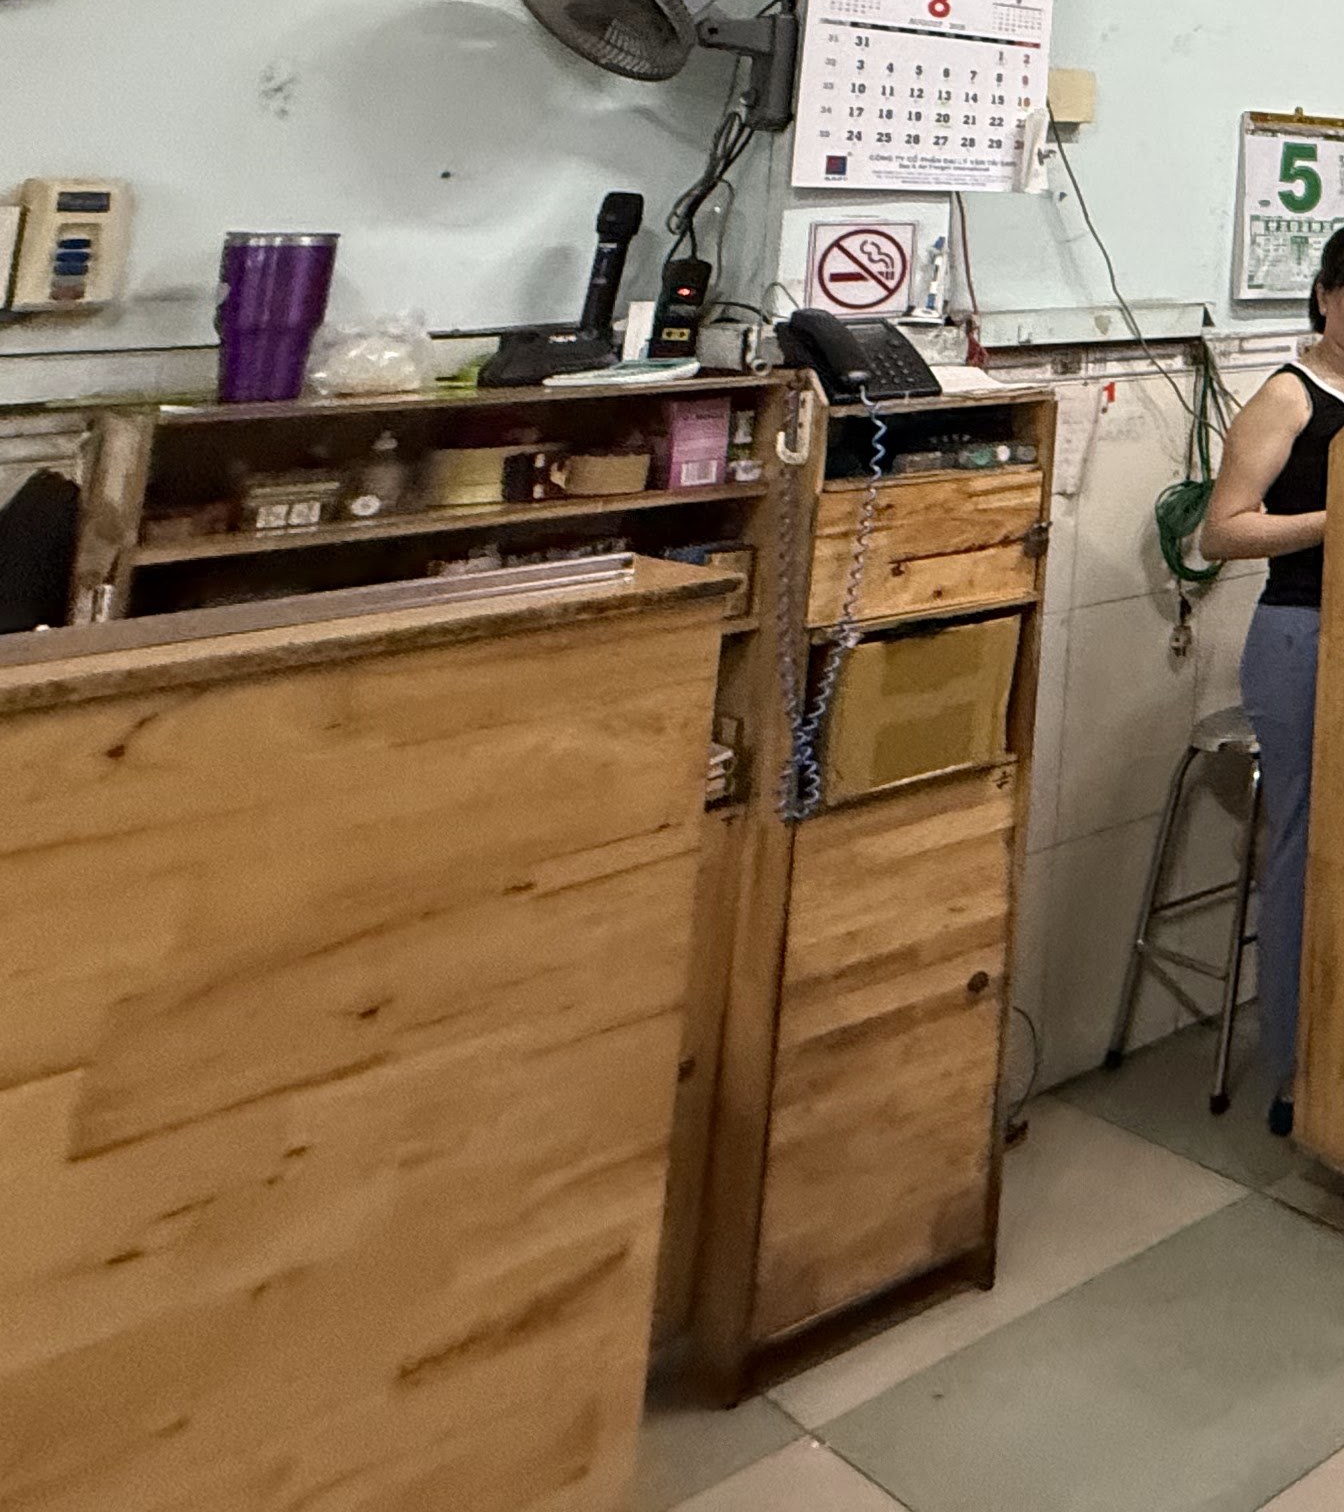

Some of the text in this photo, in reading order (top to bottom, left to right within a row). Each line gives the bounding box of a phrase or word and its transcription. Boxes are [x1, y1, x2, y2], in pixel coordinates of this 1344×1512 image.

[855, 36, 869, 47] 31
[857, 60, 864, 70] 3
[887, 63, 893, 73] 4
[916, 65, 923, 76] 5
[971, 71, 977, 80] 7
[851, 83, 866, 94] 10
[882, 86, 894, 96] 11
[910, 88, 923, 98] 12
[938, 90, 951, 101] 13
[965, 93, 978, 103] 14
[991, 95, 1004, 105] 15
[849, 107, 864, 117] 17
[879, 109, 893, 119] 18
[908, 111, 921, 121] 19
[935, 113, 950, 123] 20
[963, 115, 976, 125] 21
[989, 117, 1003, 127] 22
[847, 130, 862, 141] 24
[876, 132, 891, 143] 25
[905, 134, 920, 144] 26
[933, 136, 948, 145] 27
[961, 137, 975, 147] 28
[988, 139, 1002, 149] 29
[1277, 141, 1323, 214] 5
